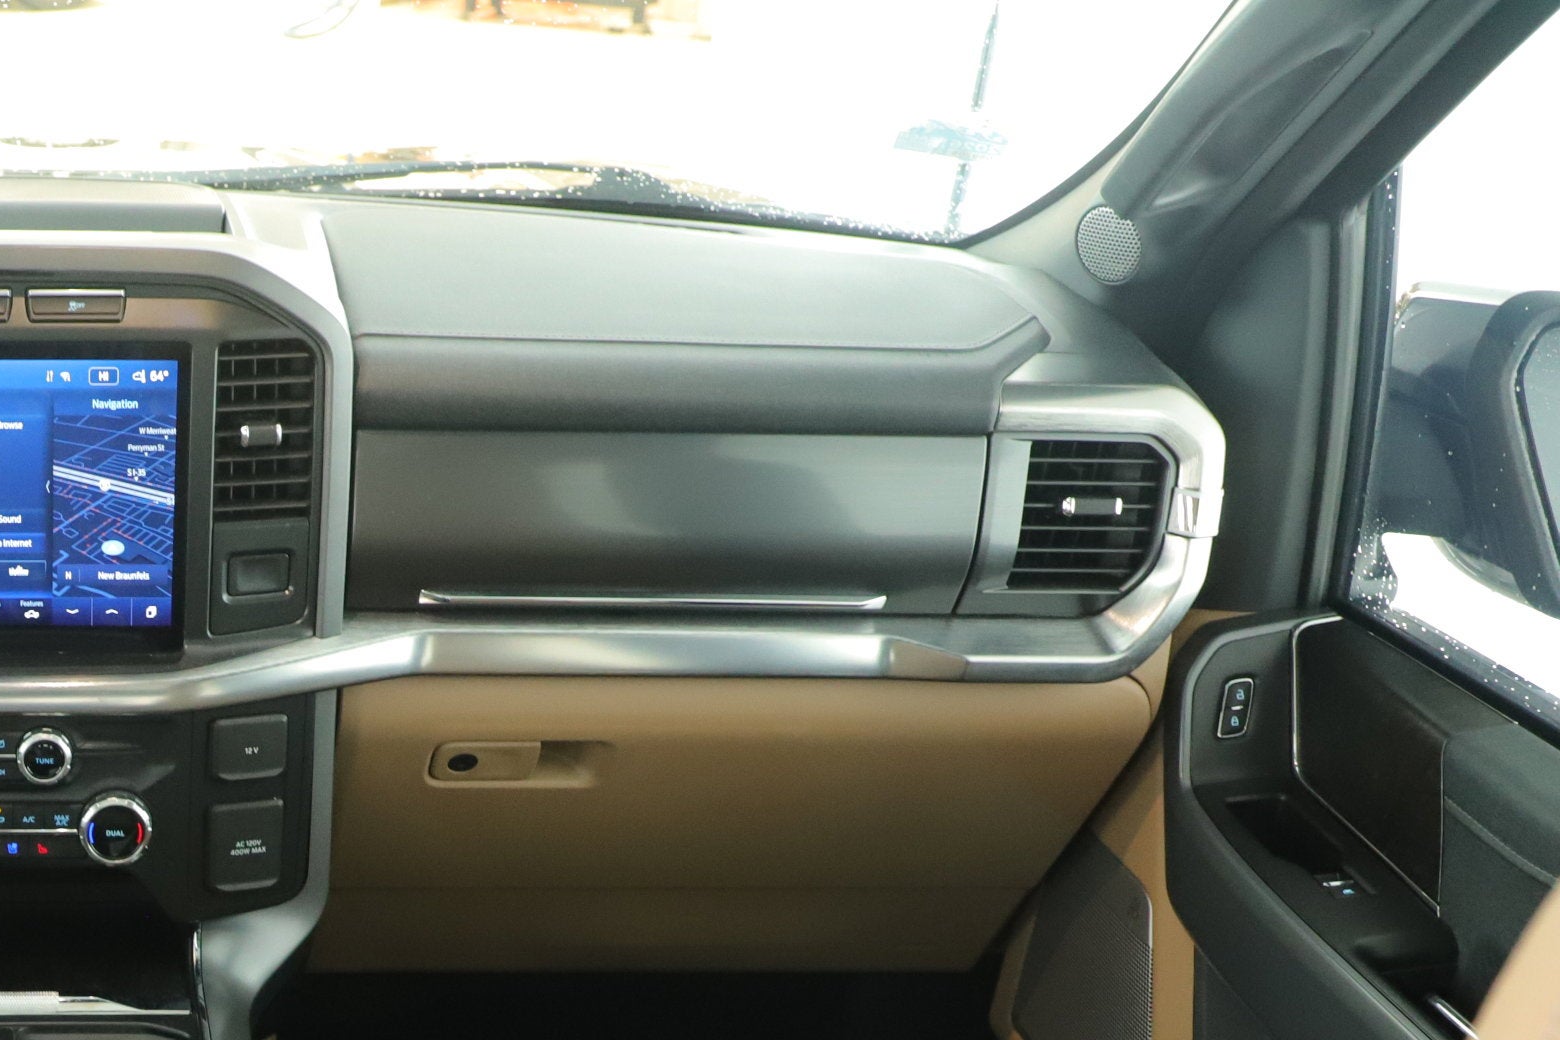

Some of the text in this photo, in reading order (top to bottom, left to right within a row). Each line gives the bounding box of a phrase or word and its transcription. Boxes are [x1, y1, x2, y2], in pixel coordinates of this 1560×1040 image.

[98, 371, 109, 382] HI
[149, 370, 170, 382] 64°
[92, 399, 139, 410] Navigation
[139, 427, 146, 435] W
[127, 444, 165, 453] Perryman St
[127, 468, 147, 477] S I-35
[3, 539, 32, 548] Internet
[65, 571, 72, 580] N
[98, 571, 150, 580] New Braunfels
[20, 600, 44, 608] Features
[245, 746, 259, 755] 12 V
[246, 839, 262, 847] 120V
[230, 846, 266, 856] 400W MAX
